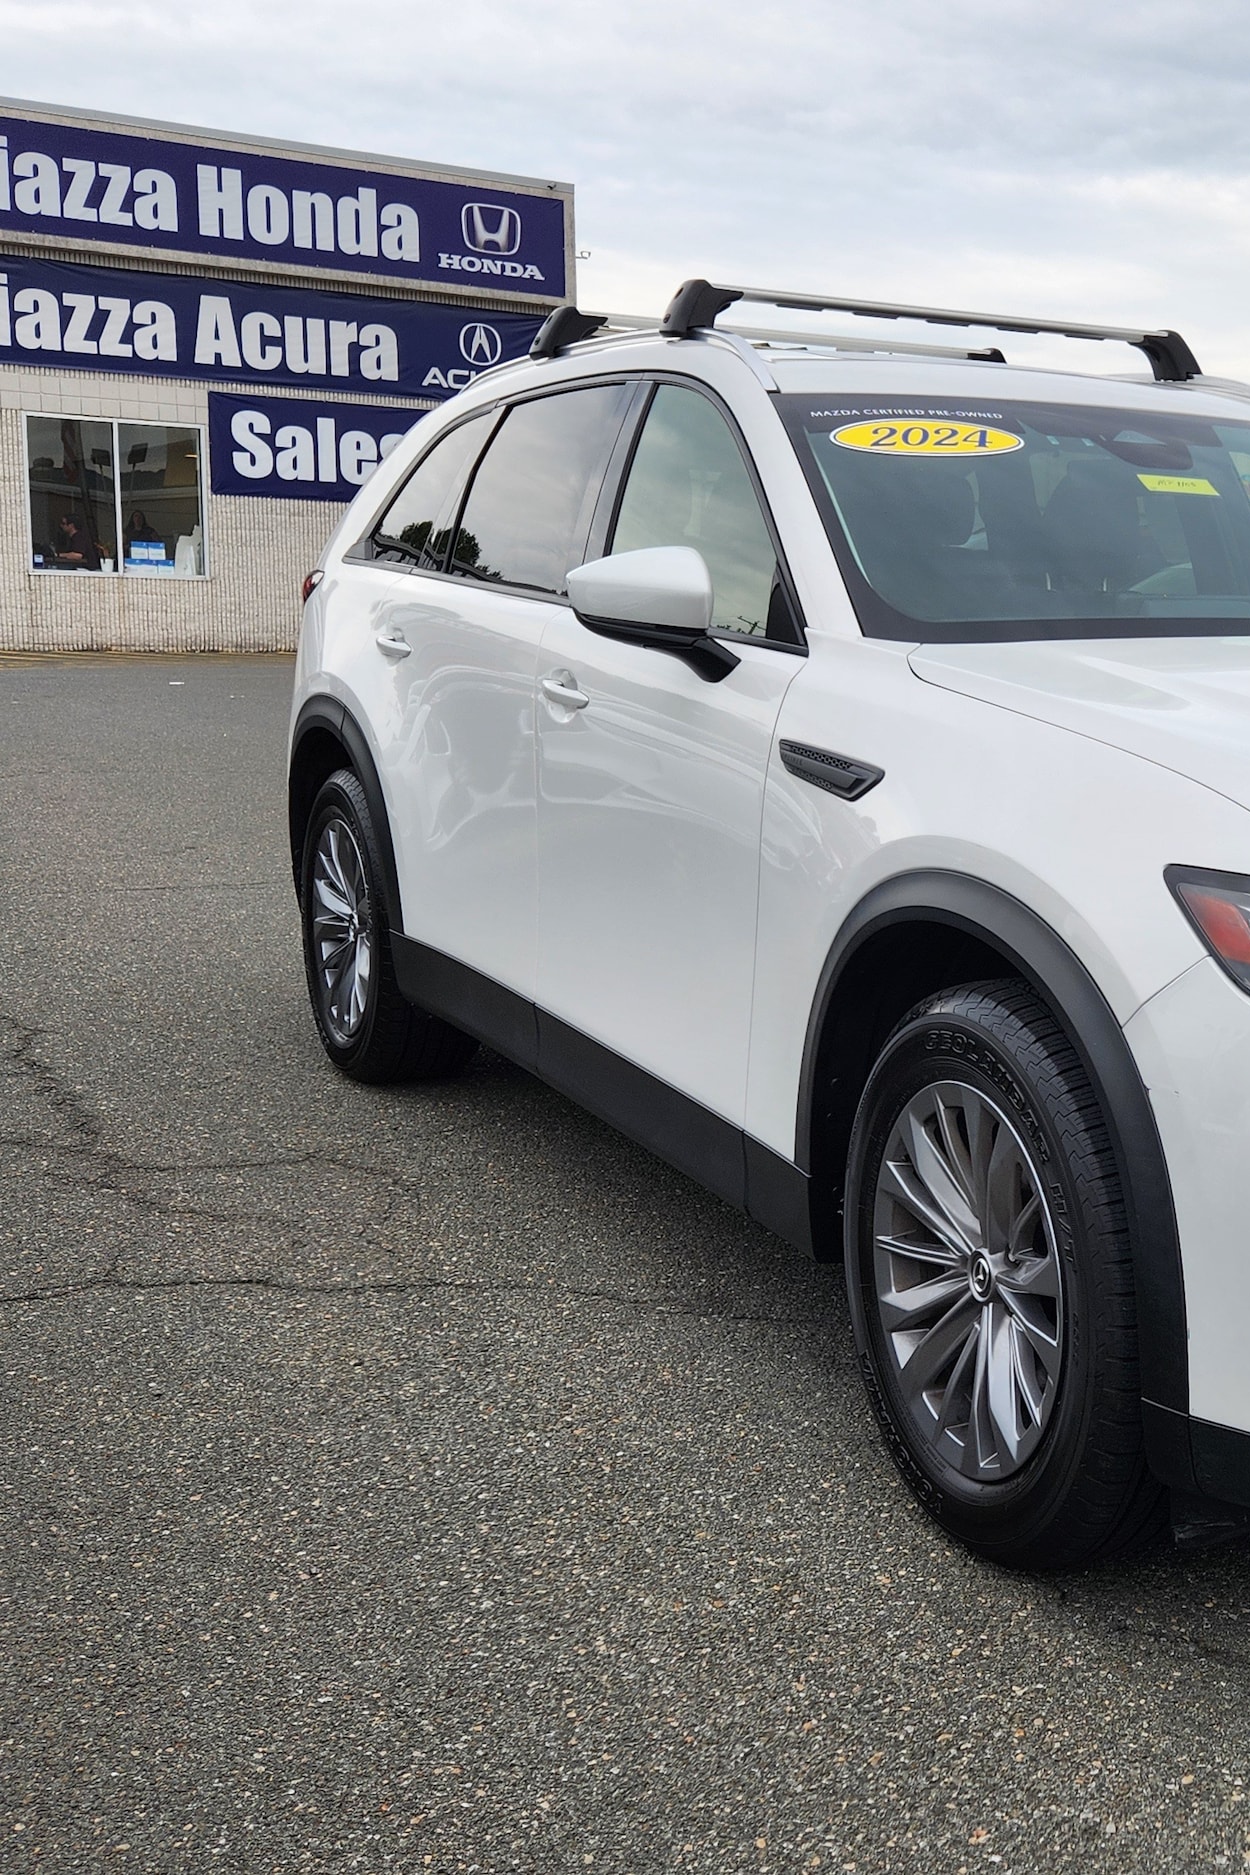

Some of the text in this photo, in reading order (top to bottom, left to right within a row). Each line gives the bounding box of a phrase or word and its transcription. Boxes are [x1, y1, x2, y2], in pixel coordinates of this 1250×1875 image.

[0, 136, 420, 263] iazza Honda
[437, 252, 545, 281] HONDA
[0, 273, 399, 382] iazza Acura
[810, 408, 1004, 420] MAZDA CERTIFIED PRE-OWNED
[869, 427, 994, 449] 2024
